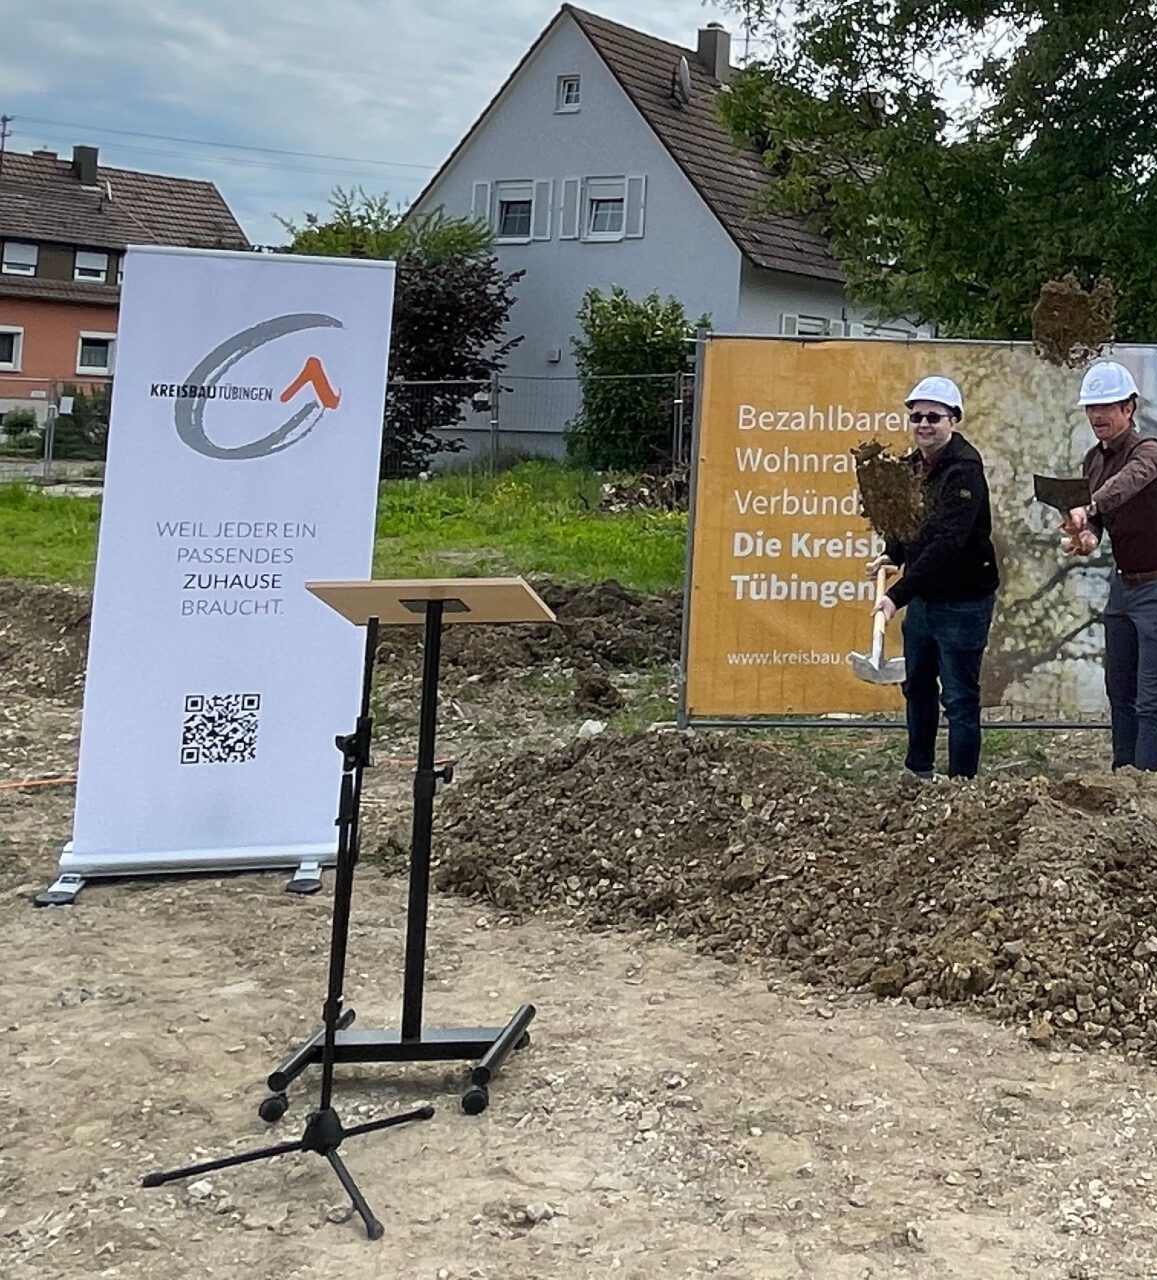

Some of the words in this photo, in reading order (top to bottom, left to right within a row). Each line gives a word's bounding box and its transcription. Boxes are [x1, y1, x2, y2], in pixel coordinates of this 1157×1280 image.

[734, 488, 864, 516] Verbünd
[156, 521, 208, 538] WEIL
[213, 522, 278, 539] JEDER
[283, 523, 317, 539] EIN
[733, 531, 782, 557] Die
[791, 532, 886, 558] Kreisb
[177, 547, 294, 564] PASSENDES
[182, 573, 283, 589] ZUHAUSE
[731, 573, 875, 608] Tübingen
[181, 599, 284, 616] BRAUCHT.
[727, 649, 853, 666] www.kreisbau.c
